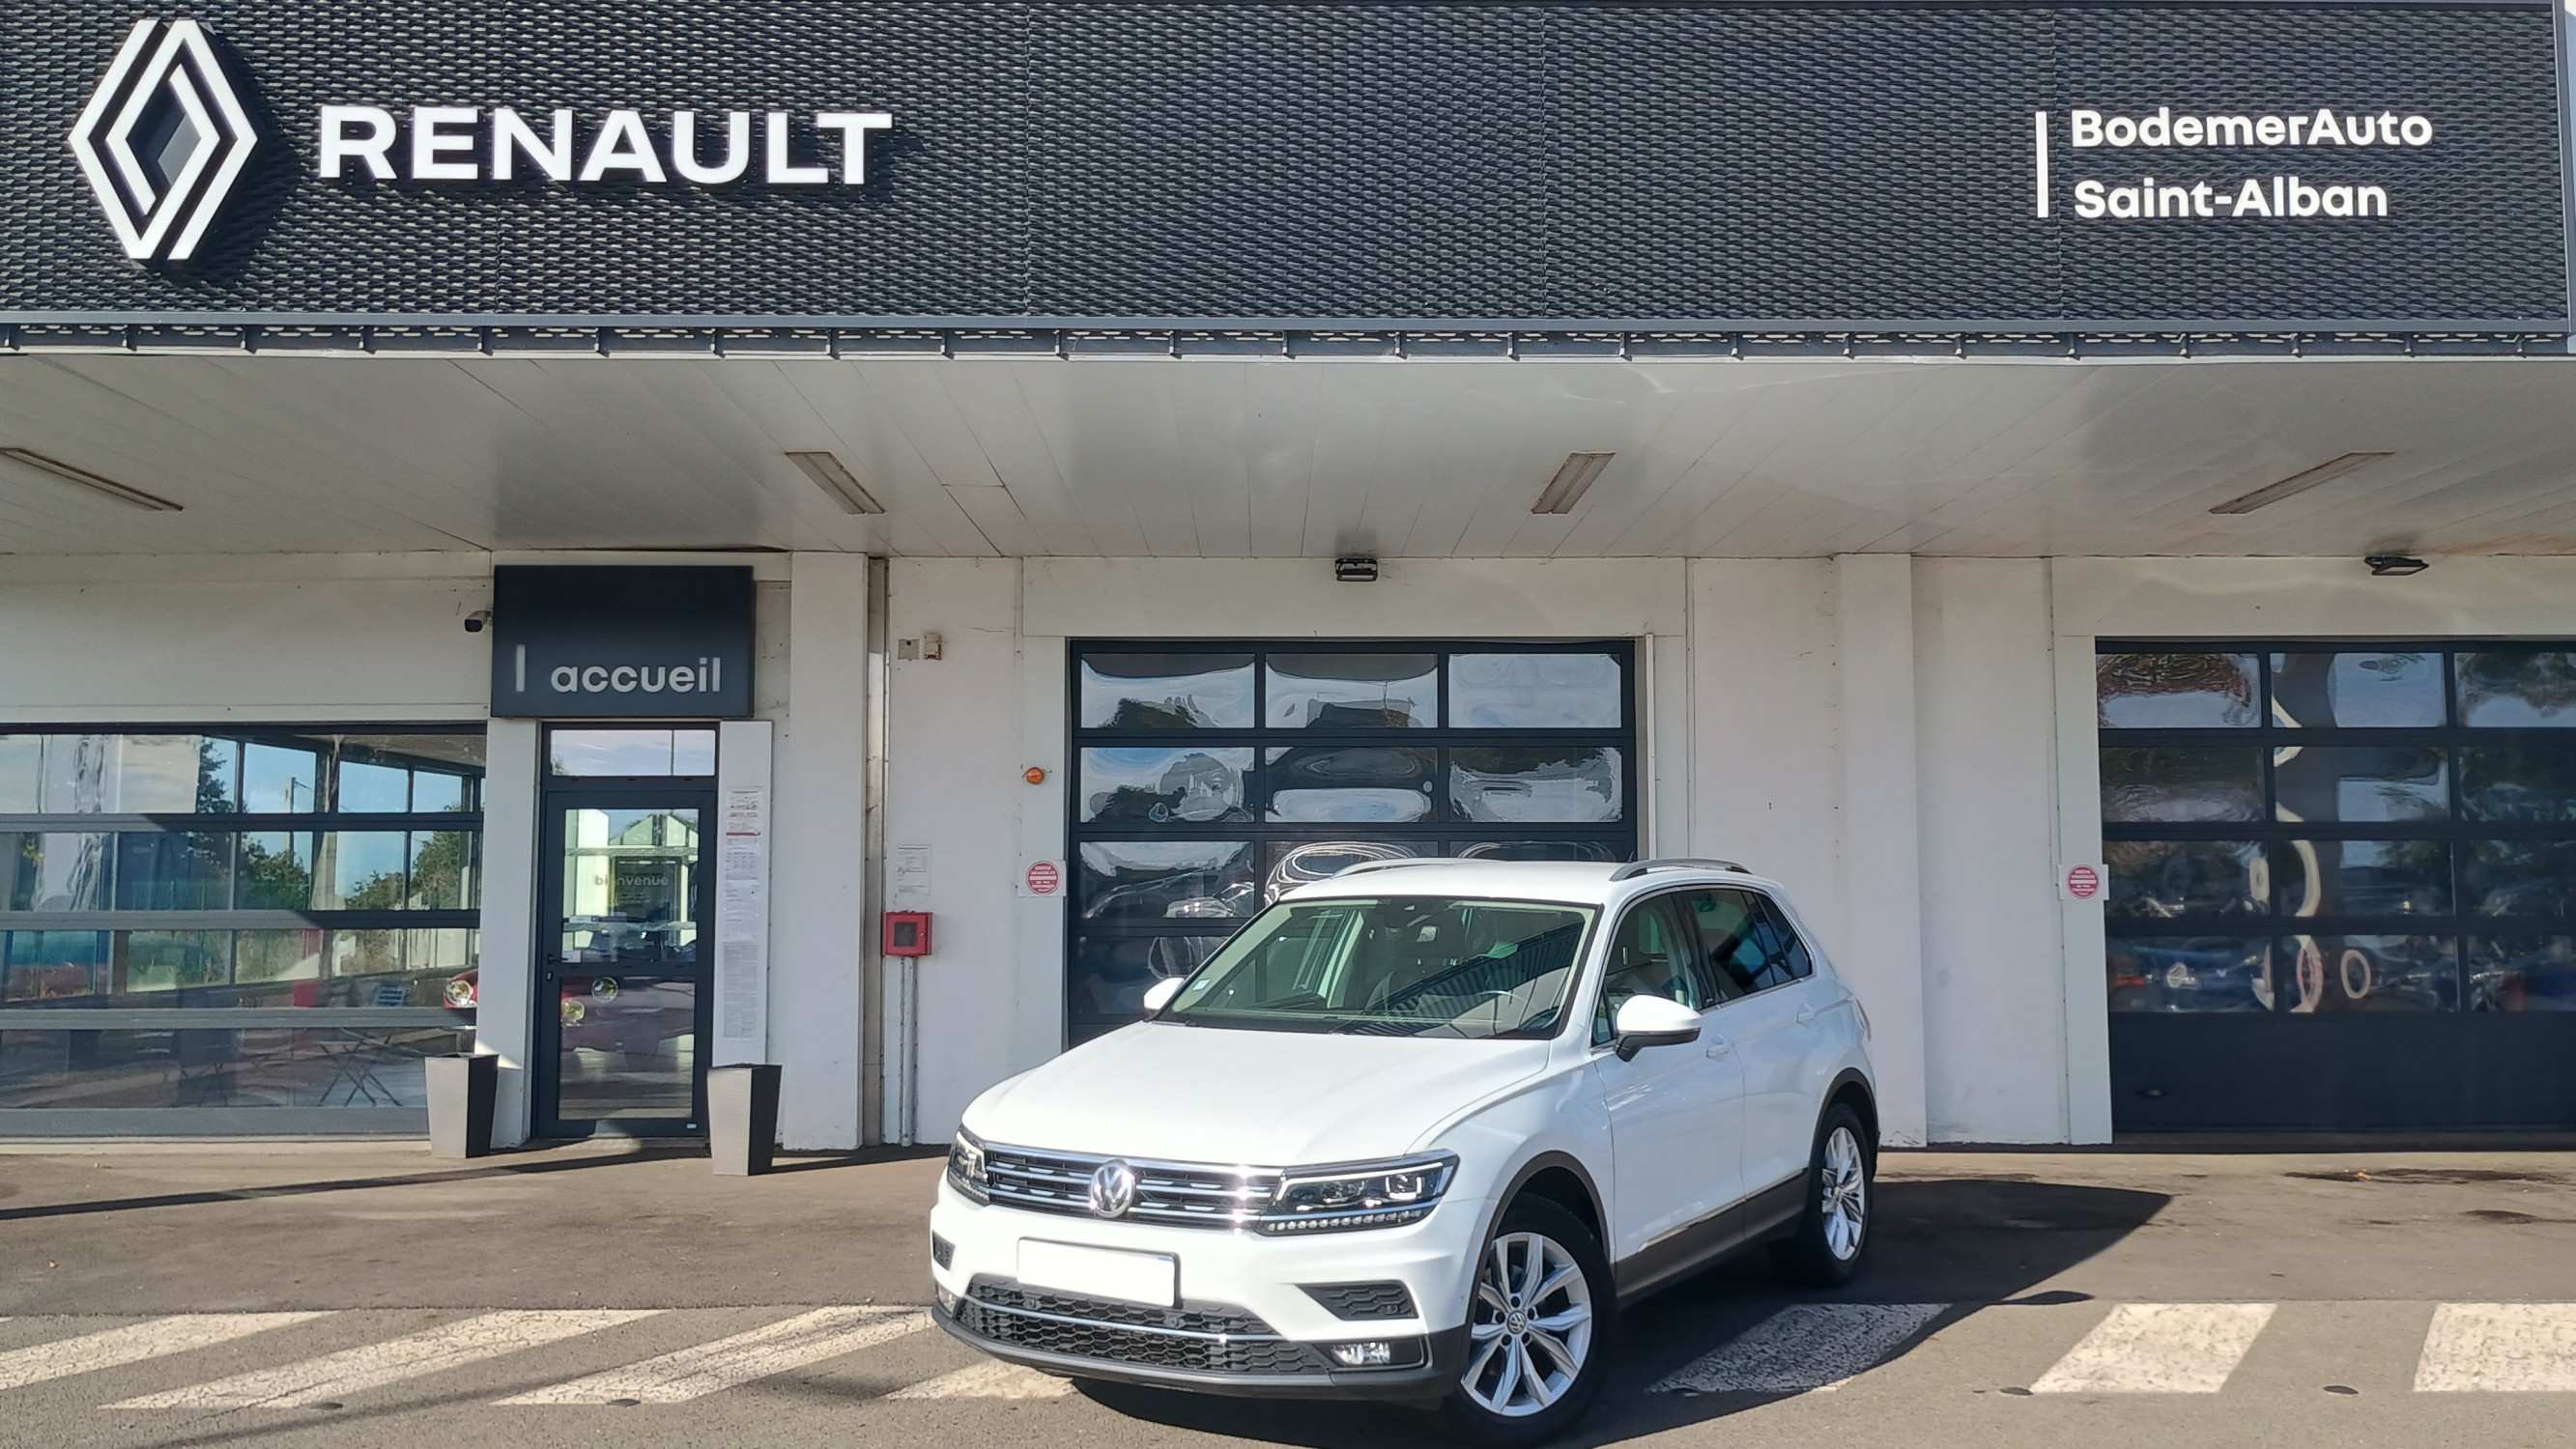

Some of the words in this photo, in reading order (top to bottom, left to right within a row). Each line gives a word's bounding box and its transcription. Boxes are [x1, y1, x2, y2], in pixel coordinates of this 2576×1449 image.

[319, 104, 893, 185] RENAULT
[2071, 106, 2434, 148] BodemerAuto
[2074, 176, 2389, 219] Saint-Alban
[551, 657, 721, 693] accueil
[595, 874, 669, 886] binvenue
